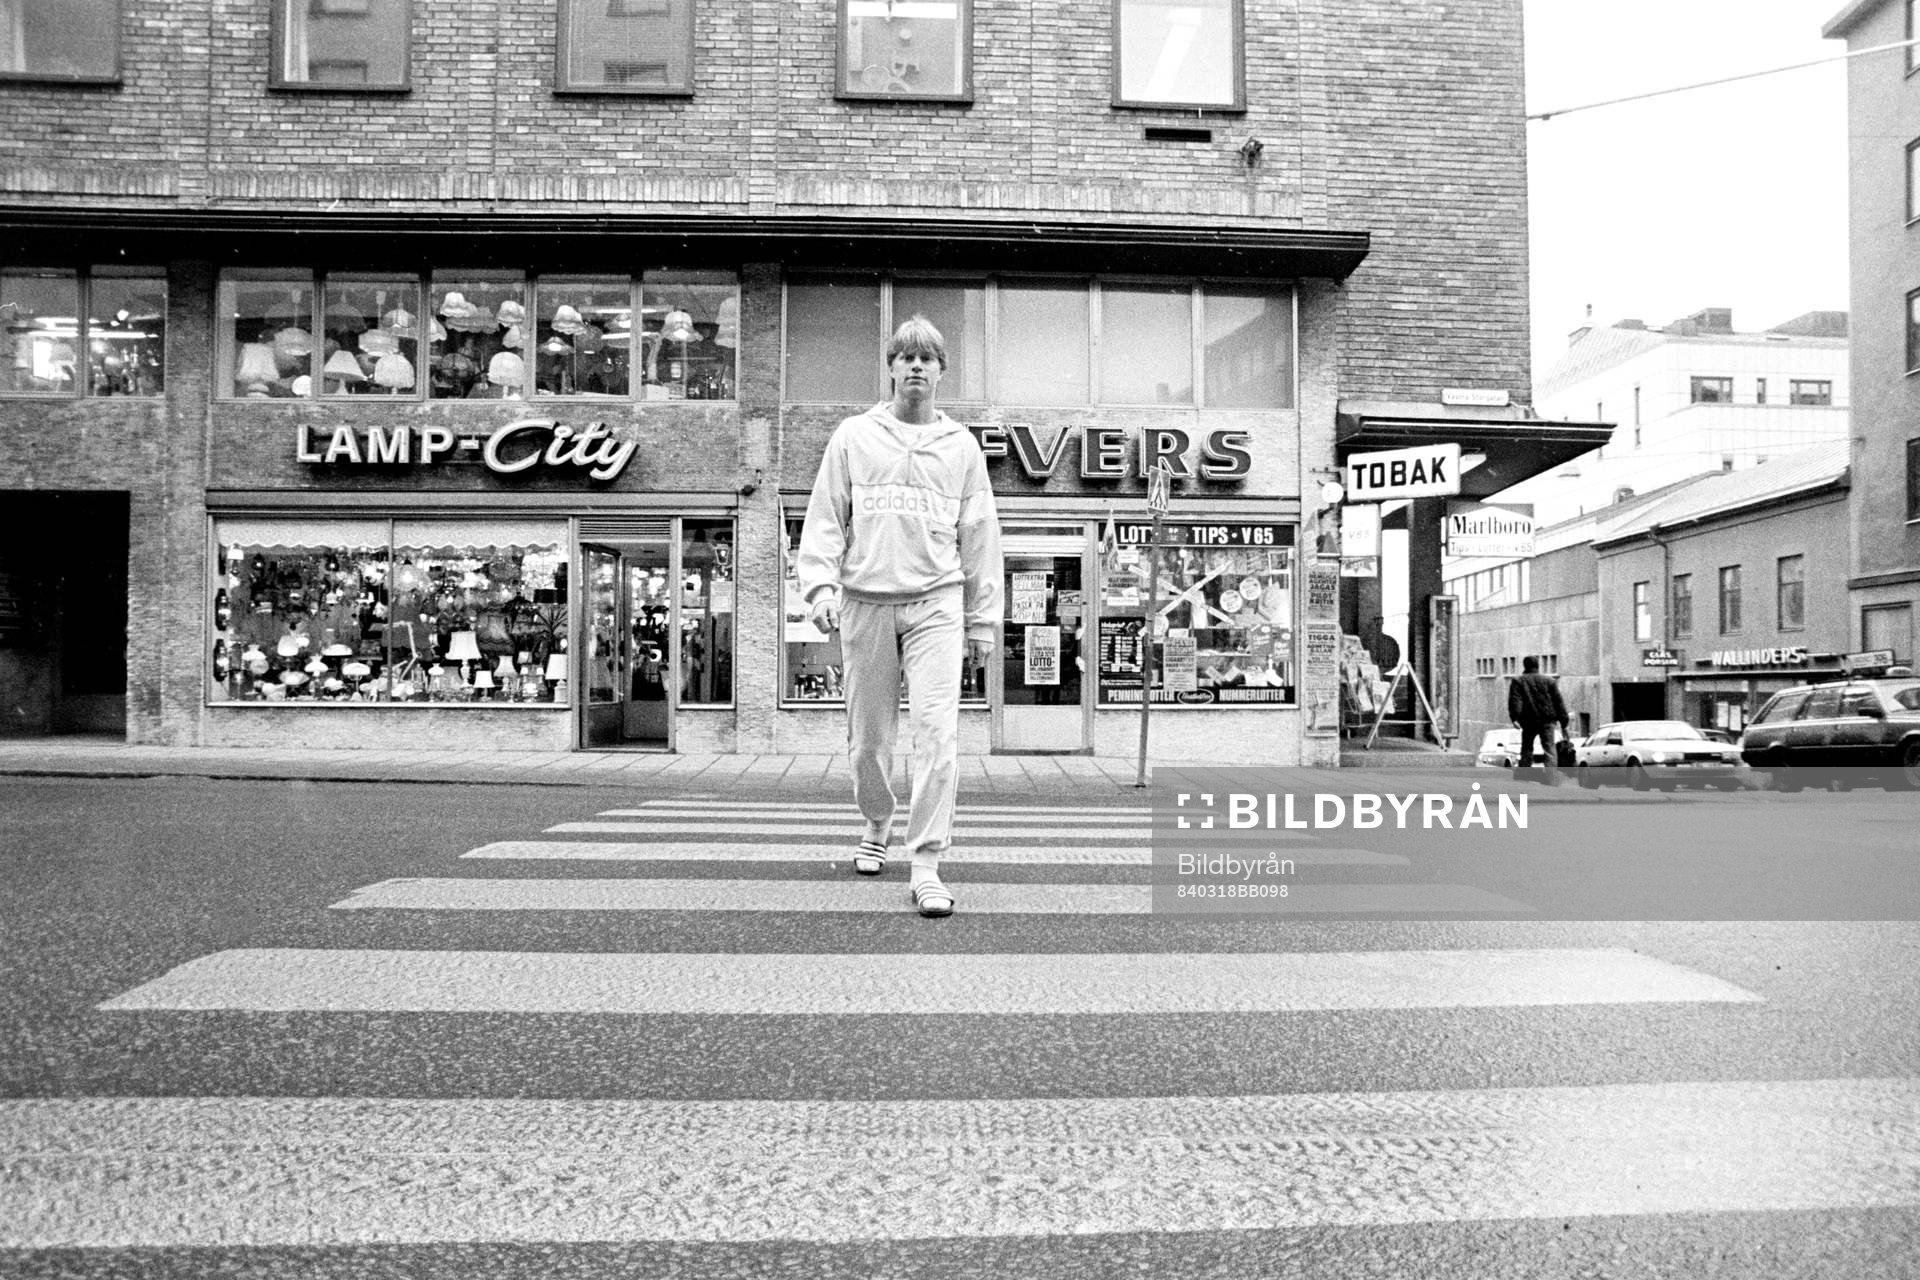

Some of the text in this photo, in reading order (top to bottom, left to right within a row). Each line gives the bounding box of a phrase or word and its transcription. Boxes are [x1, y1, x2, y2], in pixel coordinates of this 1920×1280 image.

[1352, 456, 1447, 489] TOBAK
[863, 490, 929, 513] adidas
[1192, 525, 1229, 545] TIPS
[1453, 515, 1532, 535] Marlboro
